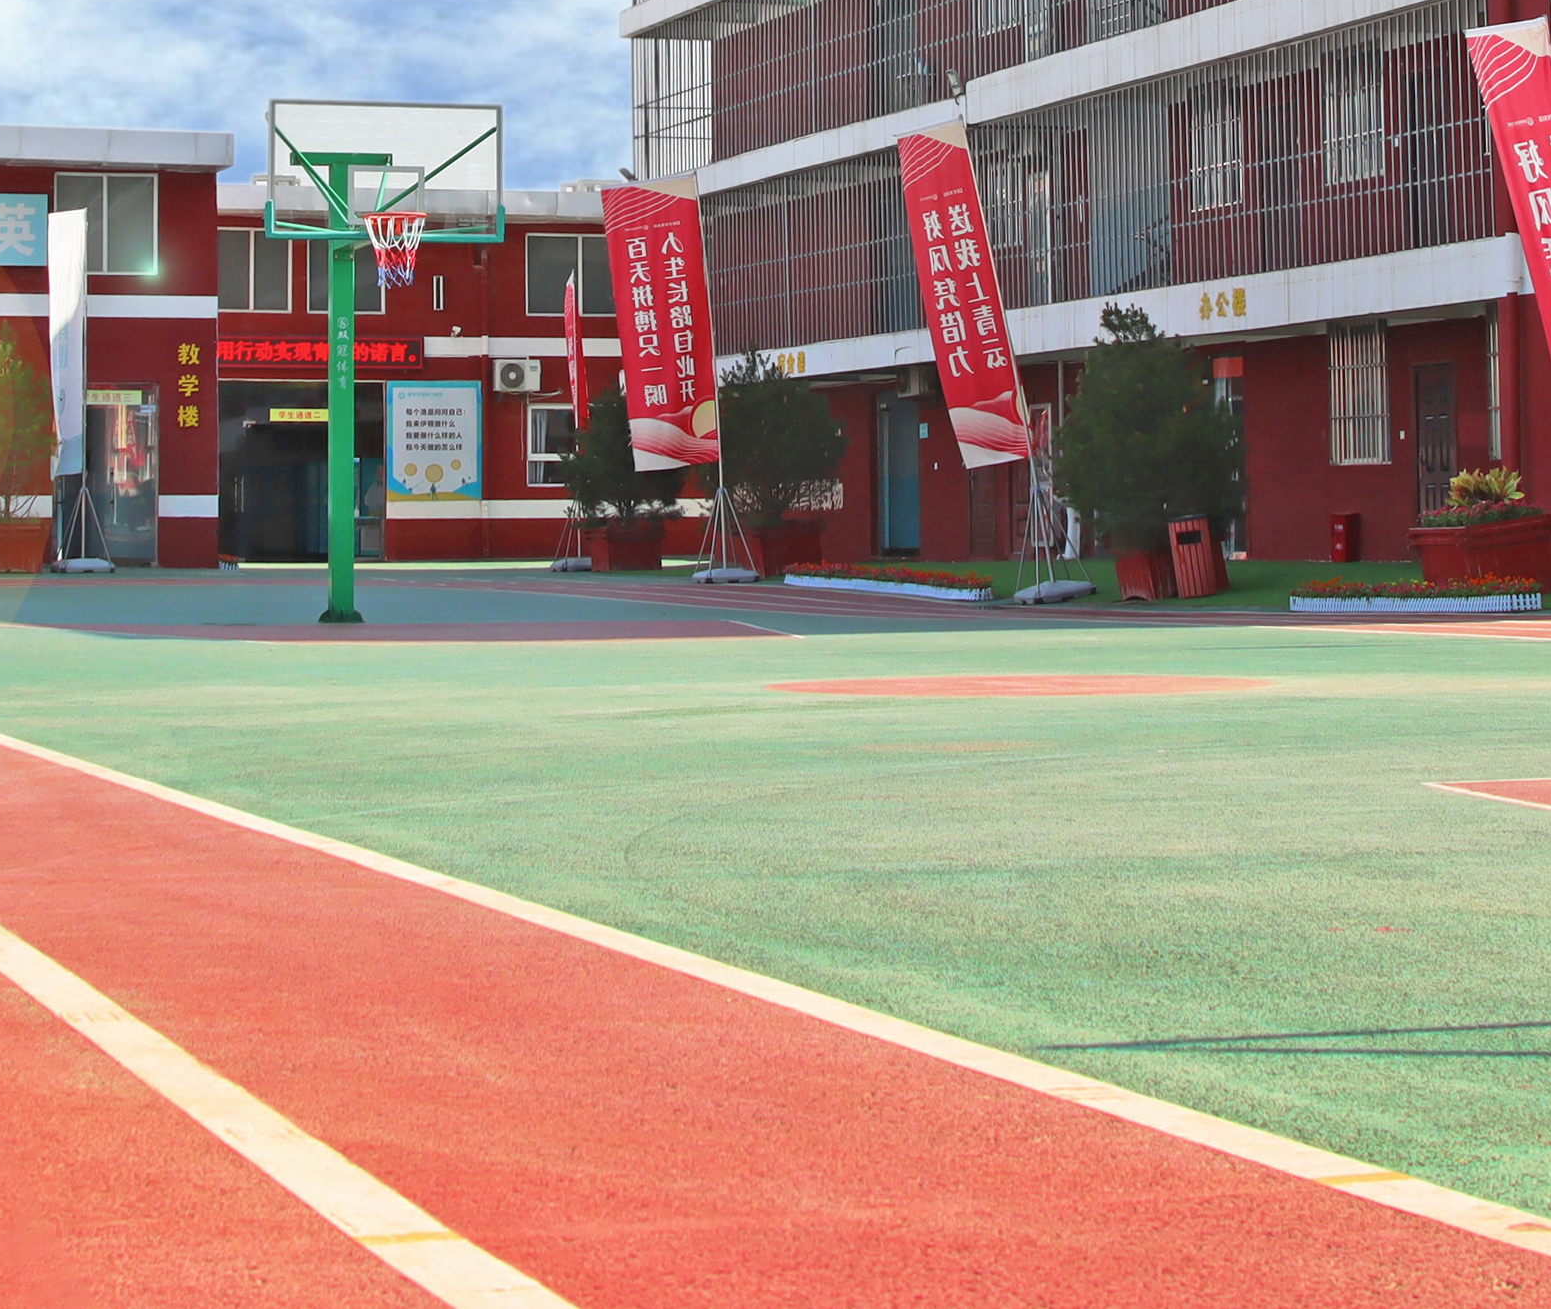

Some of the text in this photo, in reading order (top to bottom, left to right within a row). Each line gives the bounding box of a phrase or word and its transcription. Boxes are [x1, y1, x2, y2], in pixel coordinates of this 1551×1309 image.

[216, 341, 418, 363] 用行动实现青的诺言。
[177, 343, 200, 428] 教学楼
[278, 411, 322, 420] 学生通道二
